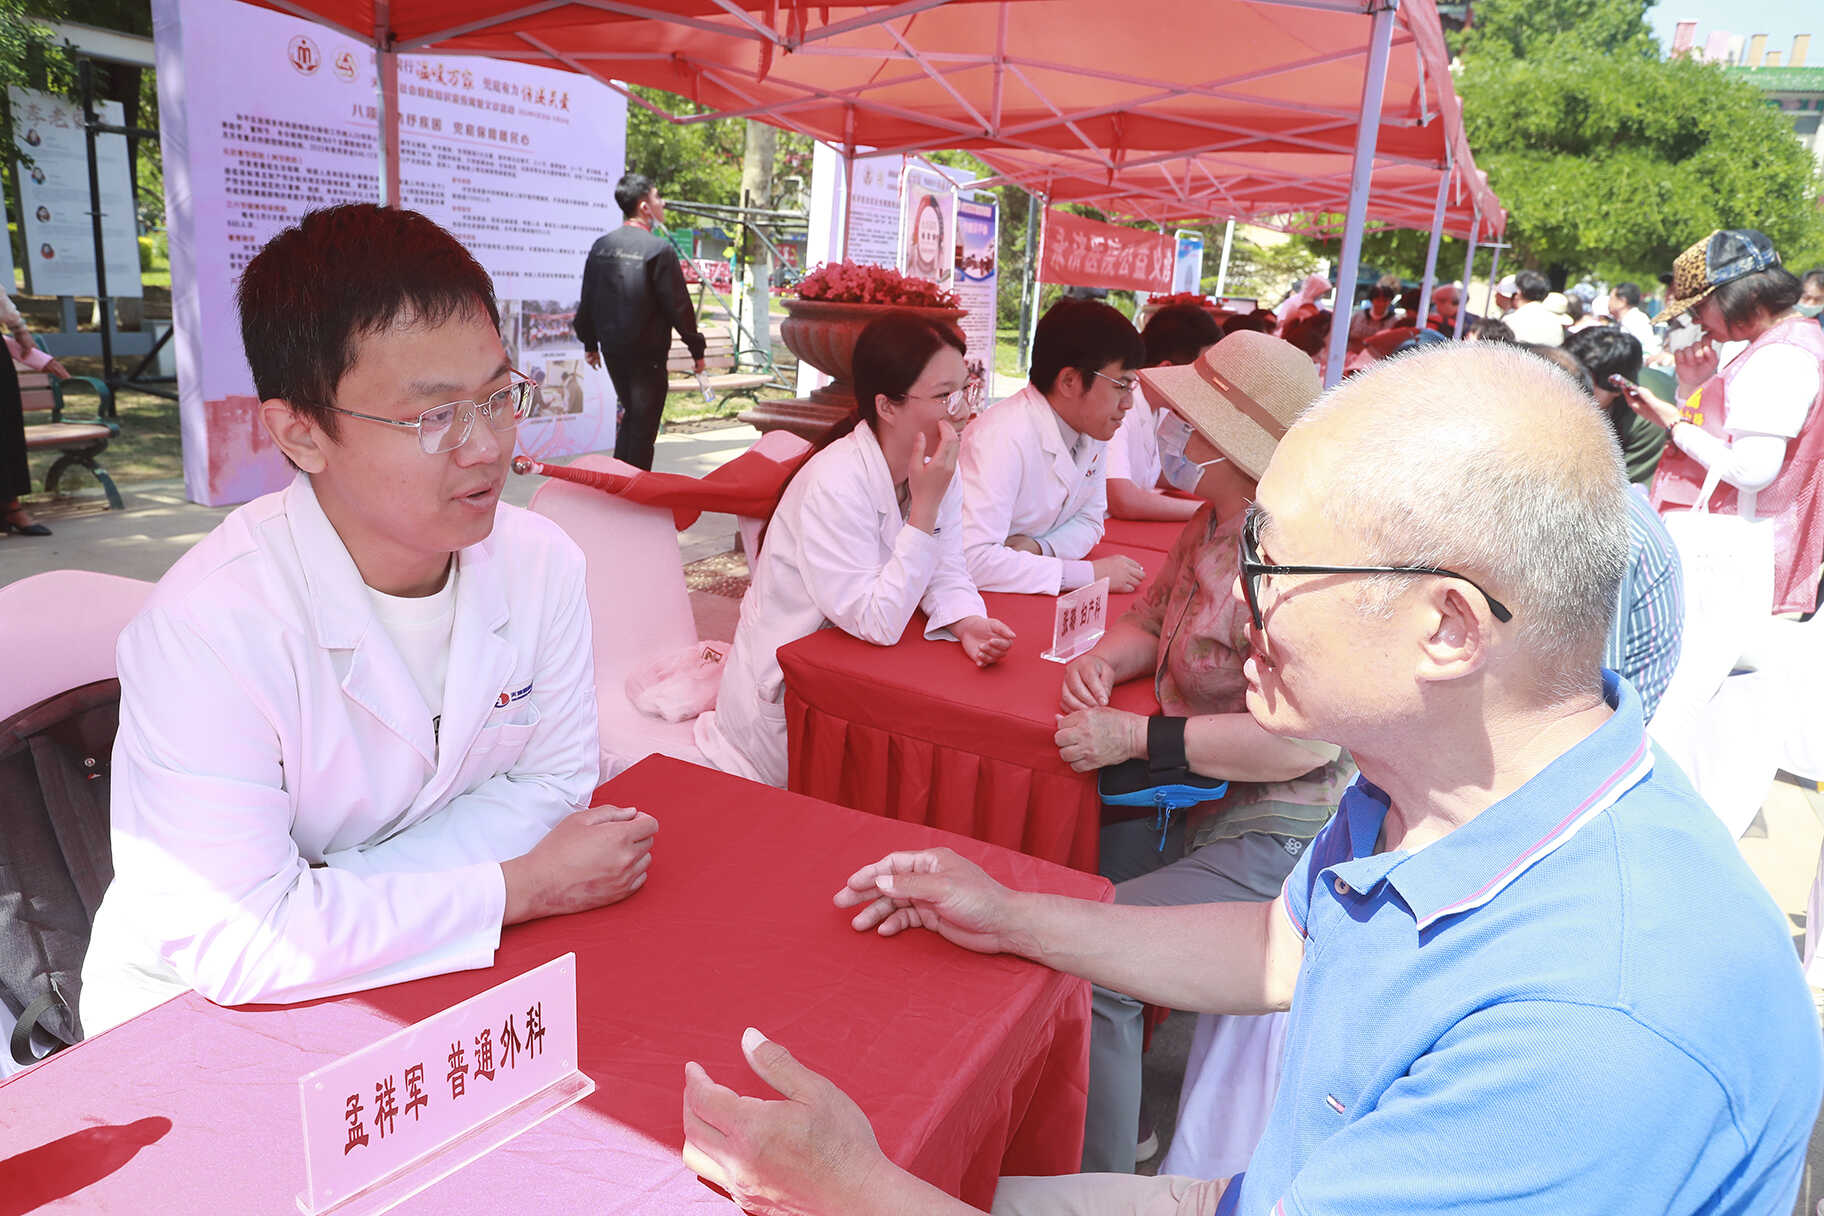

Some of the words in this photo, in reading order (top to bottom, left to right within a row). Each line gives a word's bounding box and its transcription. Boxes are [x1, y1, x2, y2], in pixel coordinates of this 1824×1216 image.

[344, 1062, 429, 1156] 孟祥军
[446, 1001, 546, 1100] 普通外科
